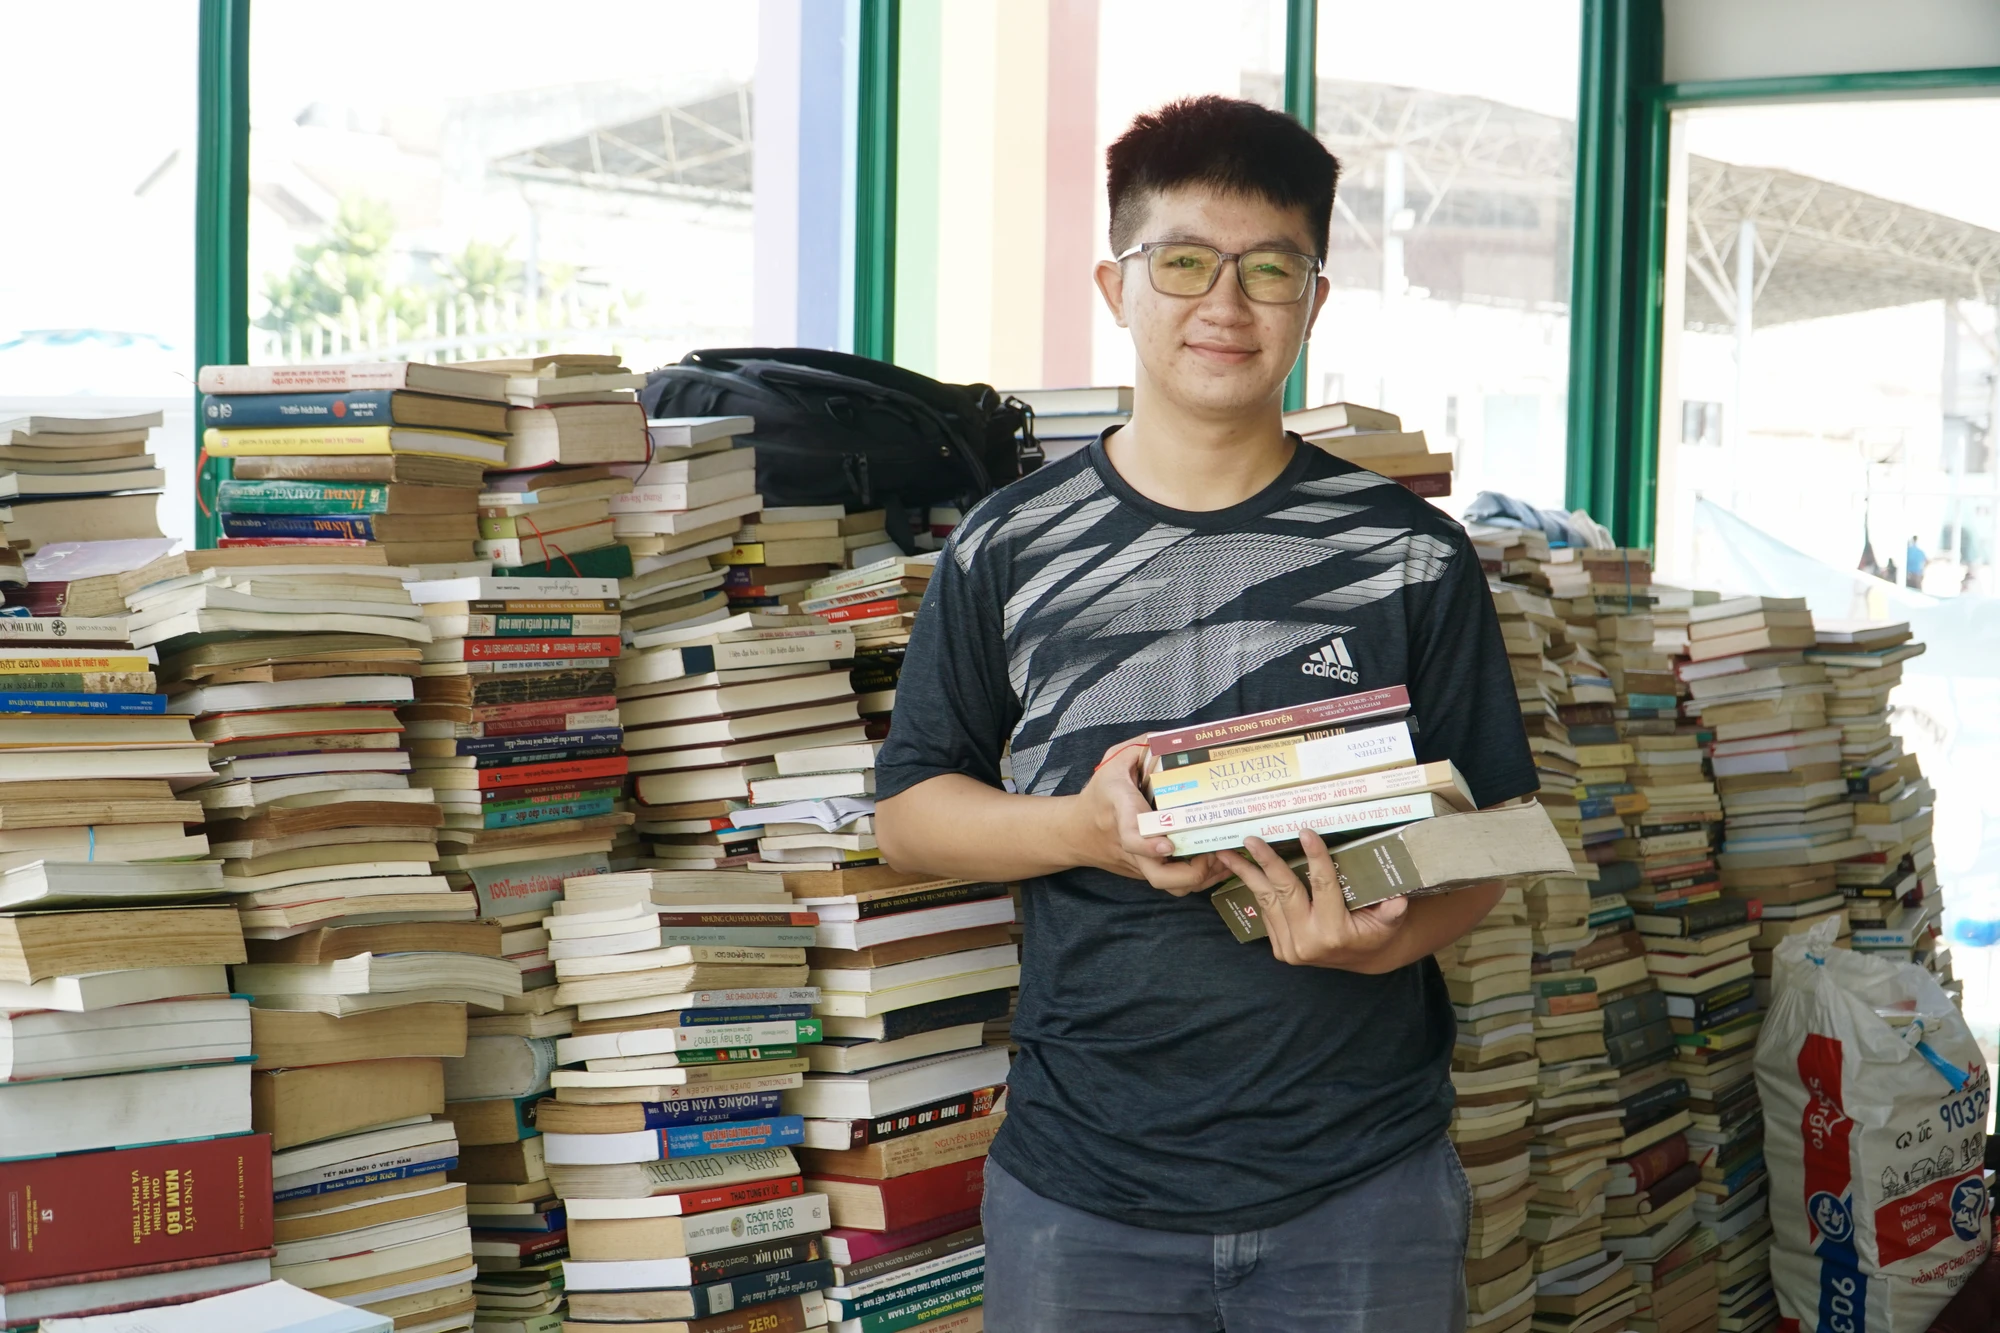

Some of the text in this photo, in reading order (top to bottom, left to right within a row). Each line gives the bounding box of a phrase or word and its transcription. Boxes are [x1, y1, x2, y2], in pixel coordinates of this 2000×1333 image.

[1302, 662, 1359, 685] adidas
[1196, 714, 1293, 740] ĐÀN BÀ TRONG TRUYỆN
[1347, 739, 1375, 751] COVEY
[1354, 746, 1392, 758] STEPHEN
[1209, 762, 1236, 780] TIN
[1212, 767, 1291, 791] TỐC ĐỘ CỦA
[1292, 792, 1306, 804] HỌC
[1308, 791, 1326, 803] CÁCH
[1333, 786, 1347, 798] DẠY
[1348, 785, 1367, 797] CÁCH
[1223, 804, 1246, 816] TRONG
[1248, 800, 1266, 813] SỐNG
[1267, 797, 1286, 809] CÁCH
[1185, 813, 1196, 824] XXI
[1208, 808, 1221, 820] THẾ
[1261, 825, 1285, 837] LÀNG
[1287, 821, 1300, 833] XÃ
[1310, 816, 1335, 829] CHÂU
[1346, 811, 1358, 824] VÀ
[1360, 810, 1367, 821] Ở
[1368, 808, 1391, 821] VIỆT
[1392, 805, 1412, 816] NAM
[489, 882, 506, 900] 100
[720, 1033, 733, 1044] hay
[692, 1099, 716, 1114] VĂN
[719, 1095, 758, 1110] HOÀNG
[974, 1094, 993, 1105] HART
[663, 1101, 689, 1118] BỔN
[973, 1102, 992, 1112] JOHN
[918, 1110, 939, 1124] CAO
[877, 1119, 896, 1134] LỪA
[934, 1134, 967, 1149] NGUYỄN
[1918, 1126, 1932, 1143] ÚC
[725, 1148, 787, 1165] GRISHAM
[323, 1170, 336, 1178] TẾT
[339, 1168, 354, 1176] NĂM
[396, 1157, 412, 1165] NAM
[744, 1157, 779, 1172] JOHN
[132, 1170, 144, 1244] VÀ PHÁT TRIỂN
[142, 1176, 152, 1235] HÌNH THÀNH
[152, 1178, 162, 1231] QUÁ TRÌNH
[165, 1169, 183, 1234] NAM BỘ
[184, 1169, 197, 1231] VÙNG ĐẤT
[41, 1209, 53, 1221] ST
[1900, 1200, 1927, 1217] Không
[728, 1255, 748, 1266] Gerard
[752, 1249, 770, 1265] HỌC
[772, 1246, 793, 1262] KITÔ
[939, 1292, 955, 1304] TỘC
[955, 1287, 970, 1298] DÂN
[906, 1302, 922, 1314] VIỆT
[923, 1296, 938, 1308] HỌC
[953, 1299, 969, 1310] TRÌNH
[888, 1308, 904, 1320] NAM
[930, 1303, 952, 1316] NGHIÊN
[748, 1314, 778, 1332] ZERO
